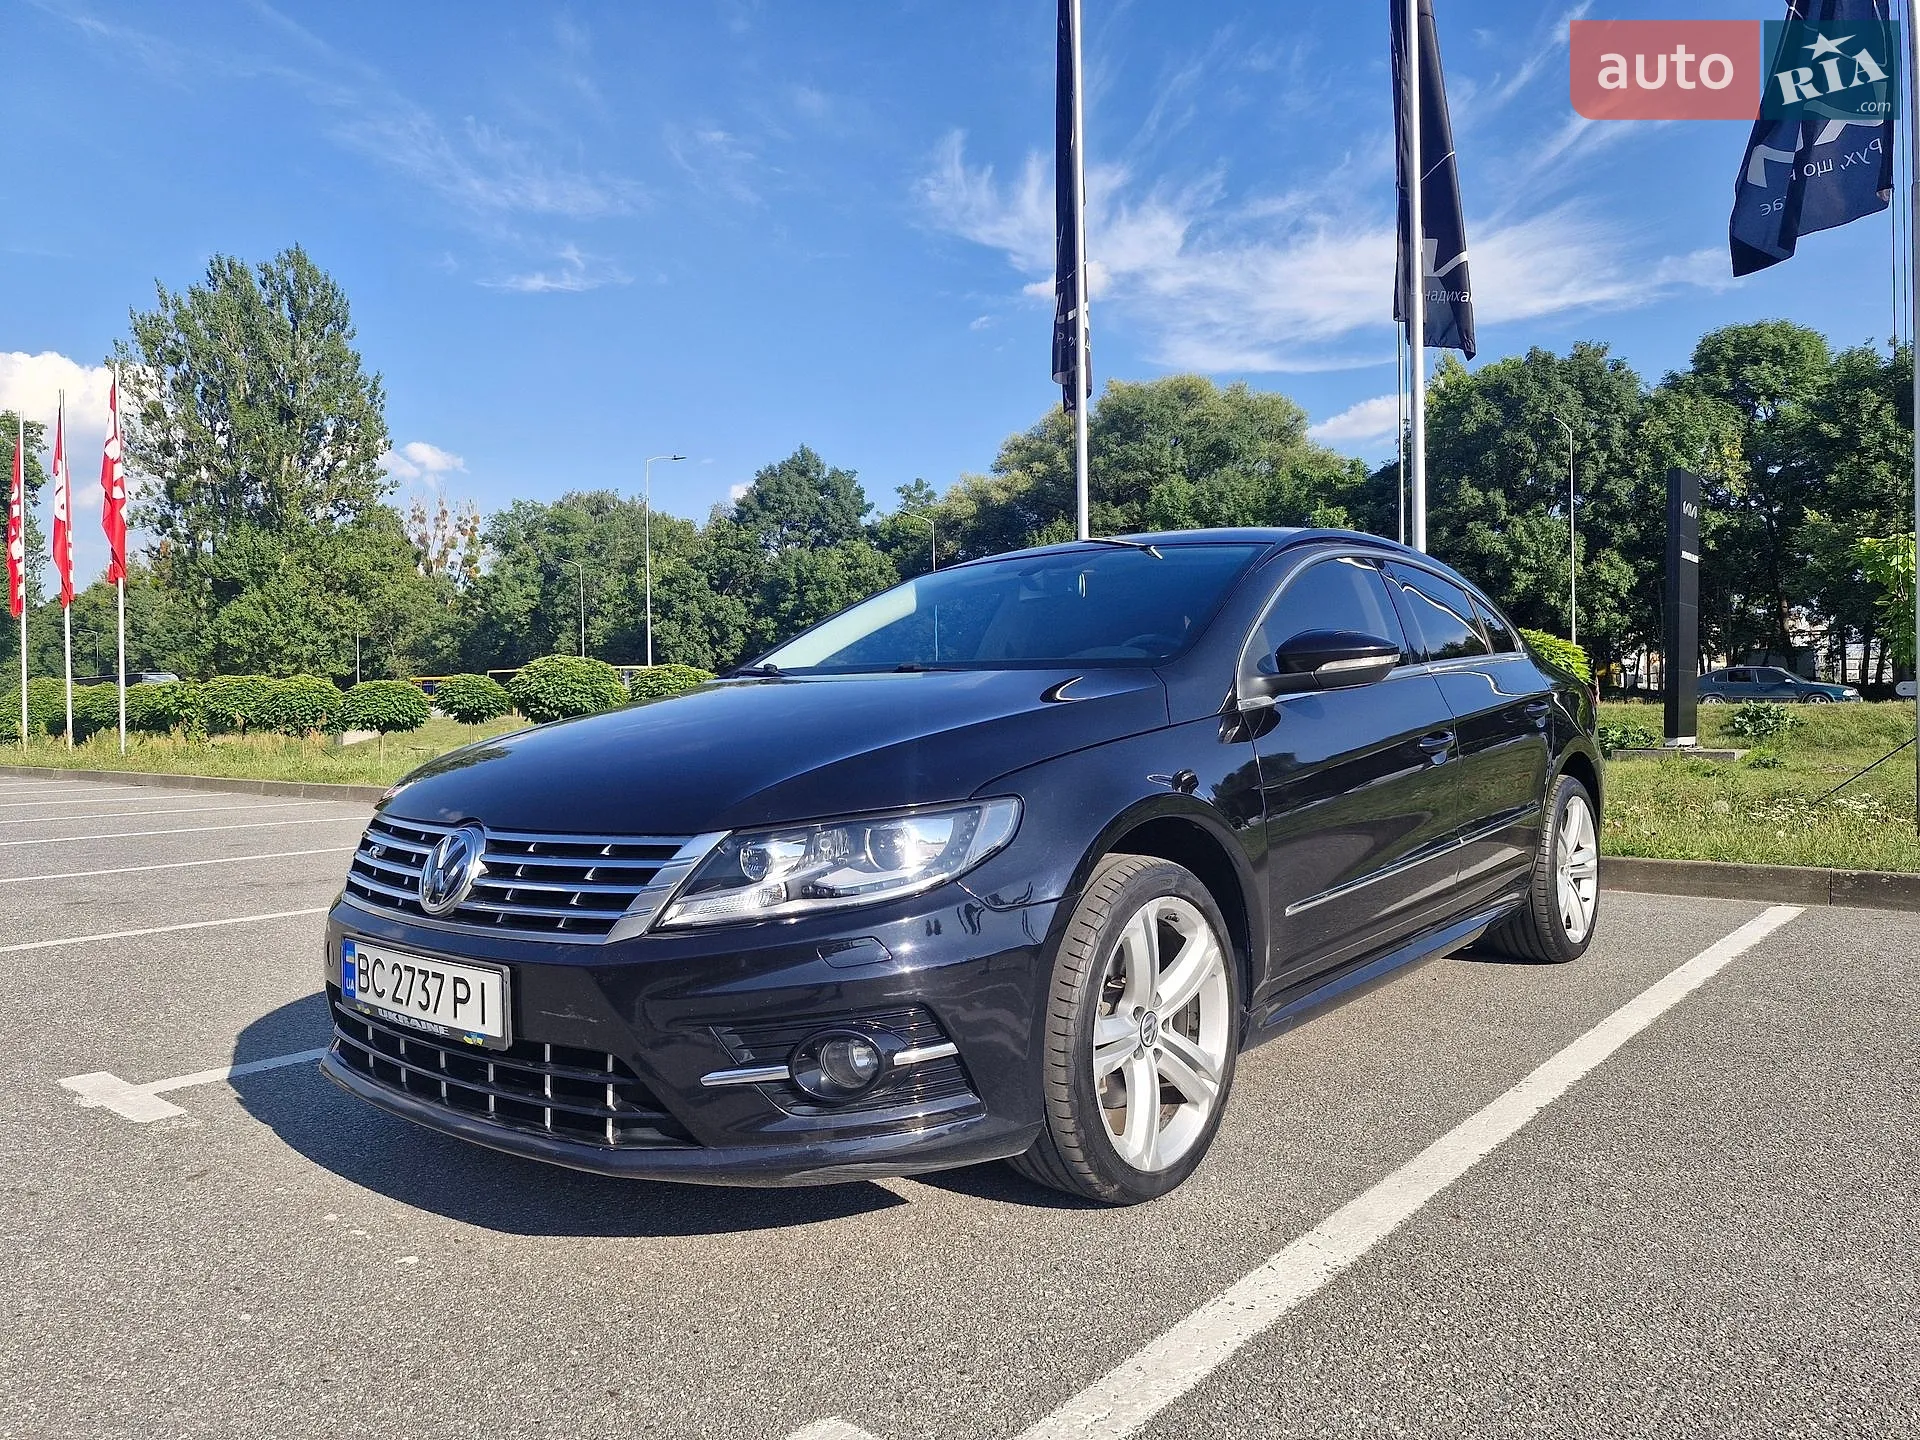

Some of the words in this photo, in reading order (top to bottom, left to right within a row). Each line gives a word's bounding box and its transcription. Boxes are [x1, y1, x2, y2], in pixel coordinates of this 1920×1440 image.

[345, 979, 355, 991] UA
[358, 953, 386, 998] BC
[391, 963, 445, 1015] 2737
[453, 976, 486, 1025] PI
[378, 1008, 450, 1036] UKRAINE
